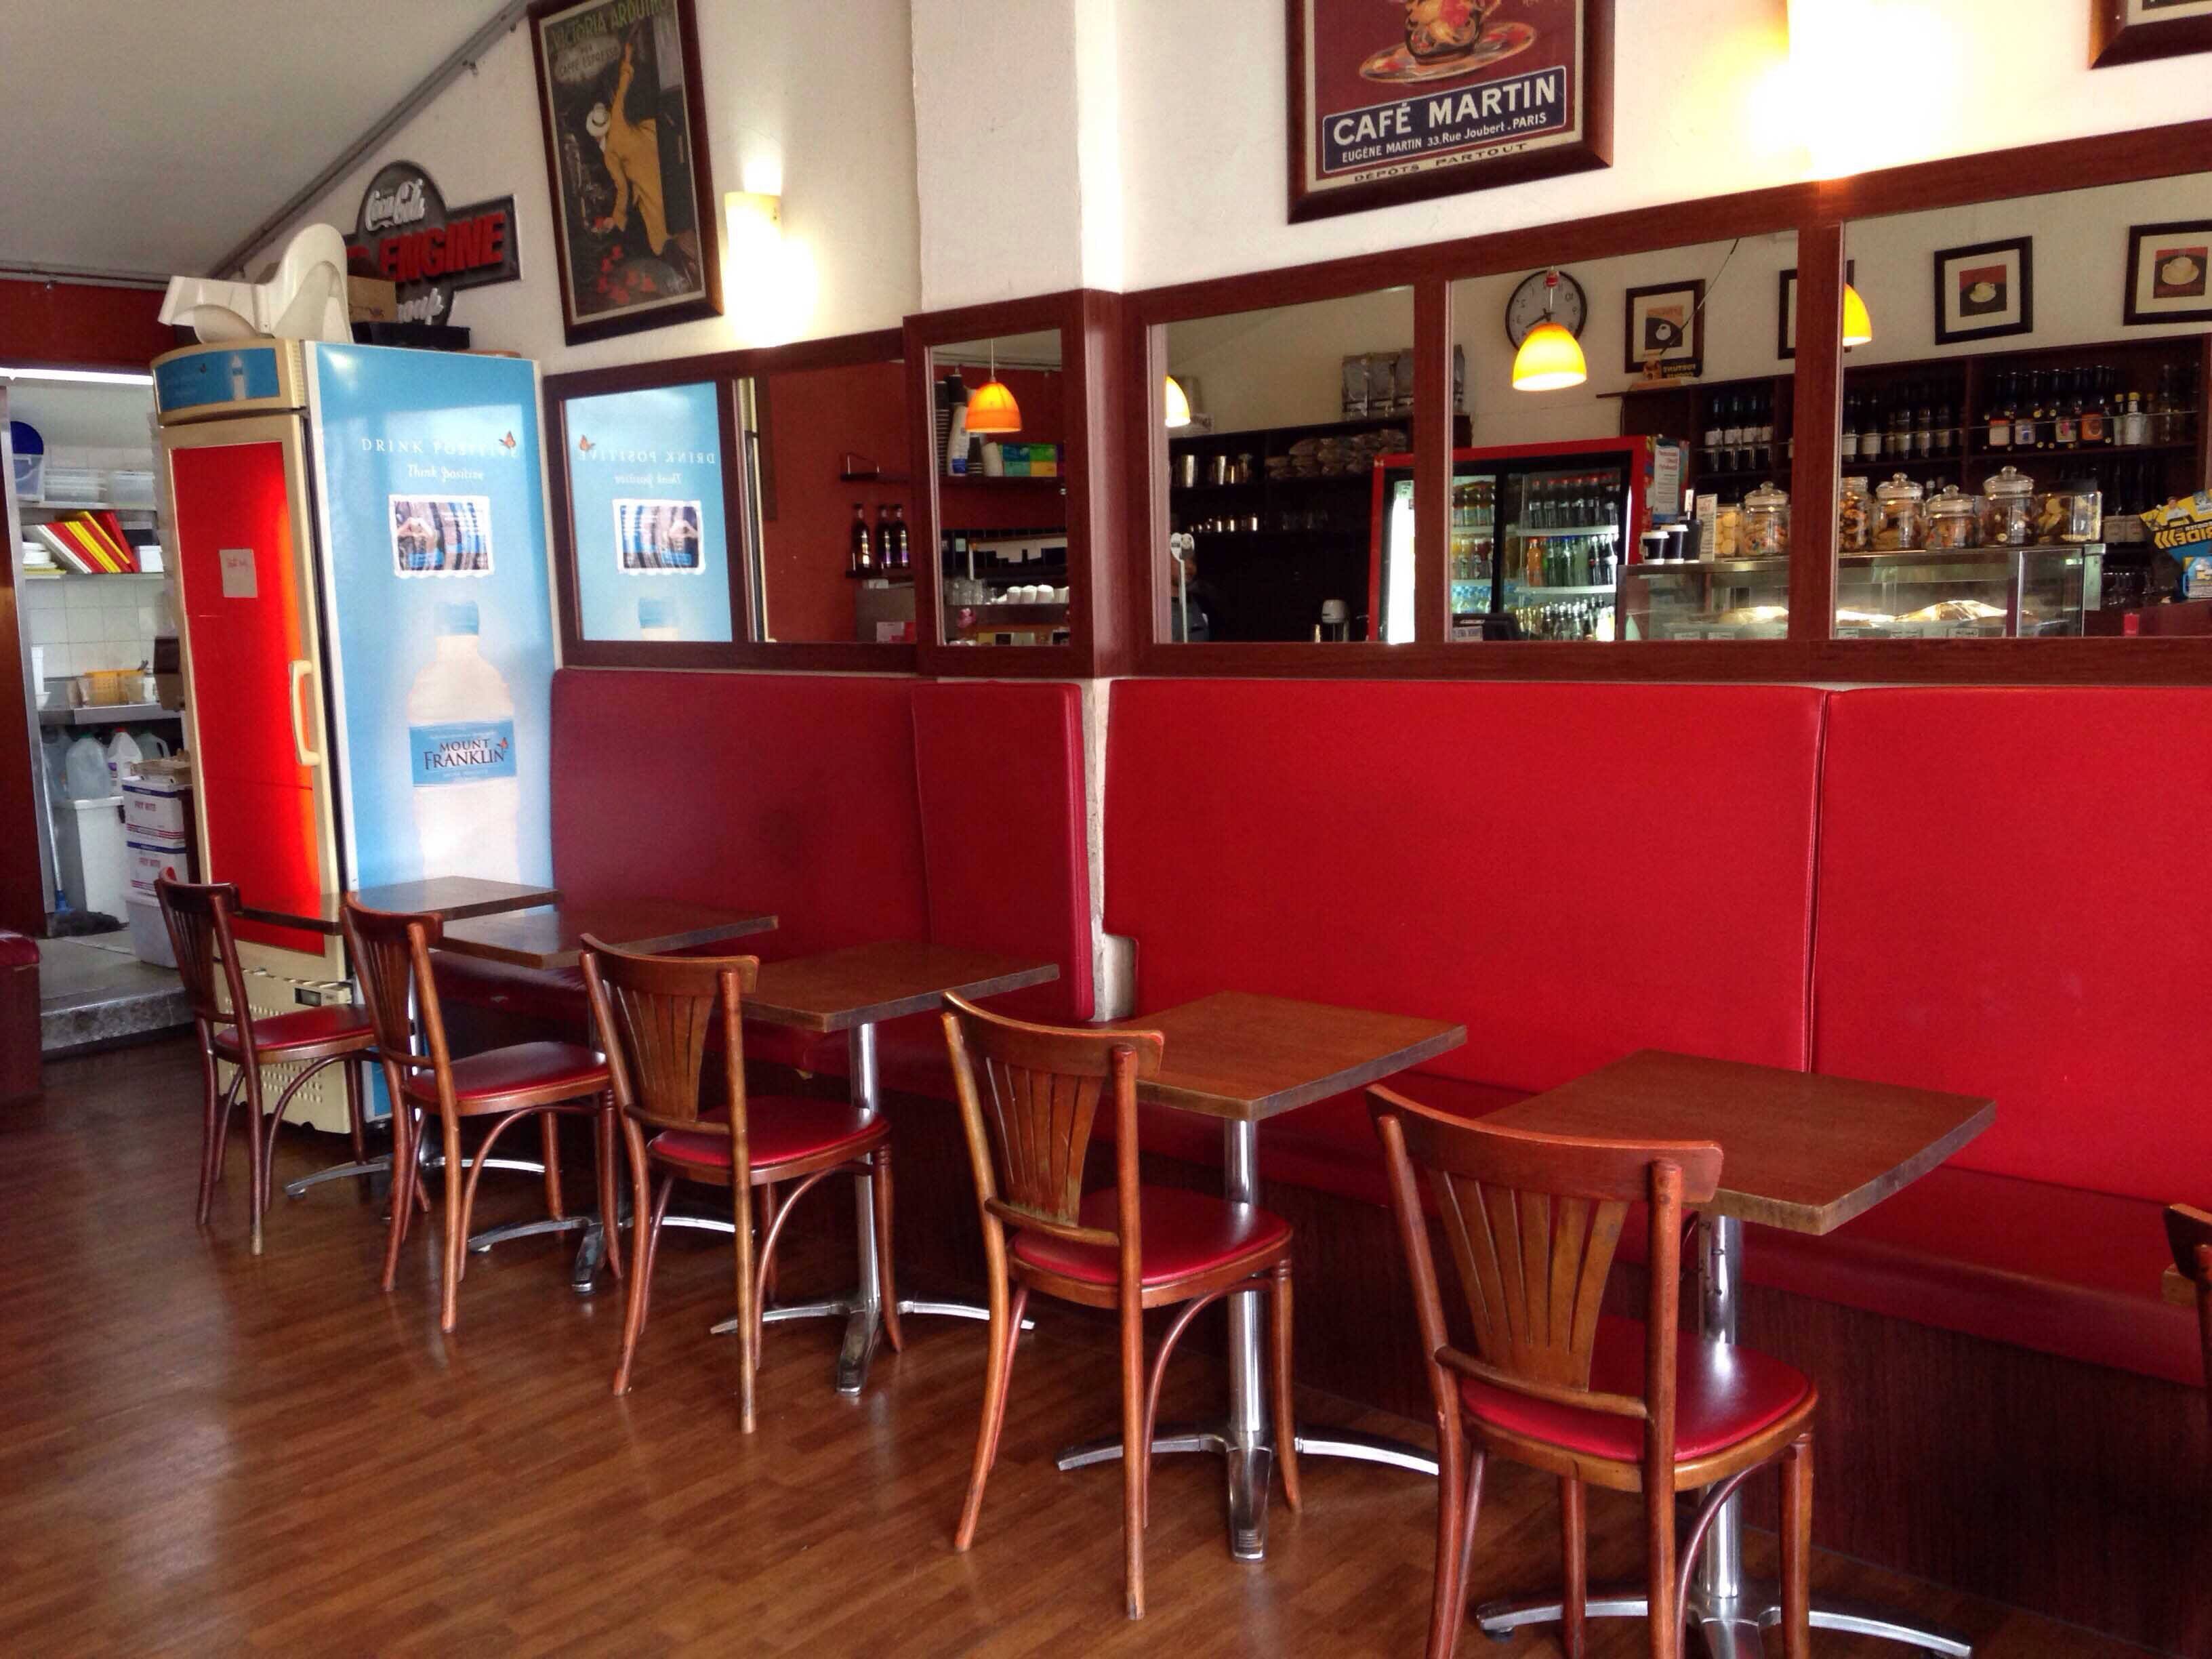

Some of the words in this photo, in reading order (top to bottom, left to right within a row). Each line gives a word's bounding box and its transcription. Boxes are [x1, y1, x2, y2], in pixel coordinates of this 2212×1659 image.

[1333, 103, 1412, 146] CAFÉ
[1429, 75, 1555, 128] MARTIN
[1386, 138, 1422, 155] MARTIN
[1464, 121, 1505, 139] Joubert
[1435, 143, 1528, 166] PARTOUT
[379, 211, 505, 281] ENGINE
[361, 438, 424, 453] DRINK
[439, 738, 491, 752] MOUNT
[424, 749, 505, 770] FRANKLIN
